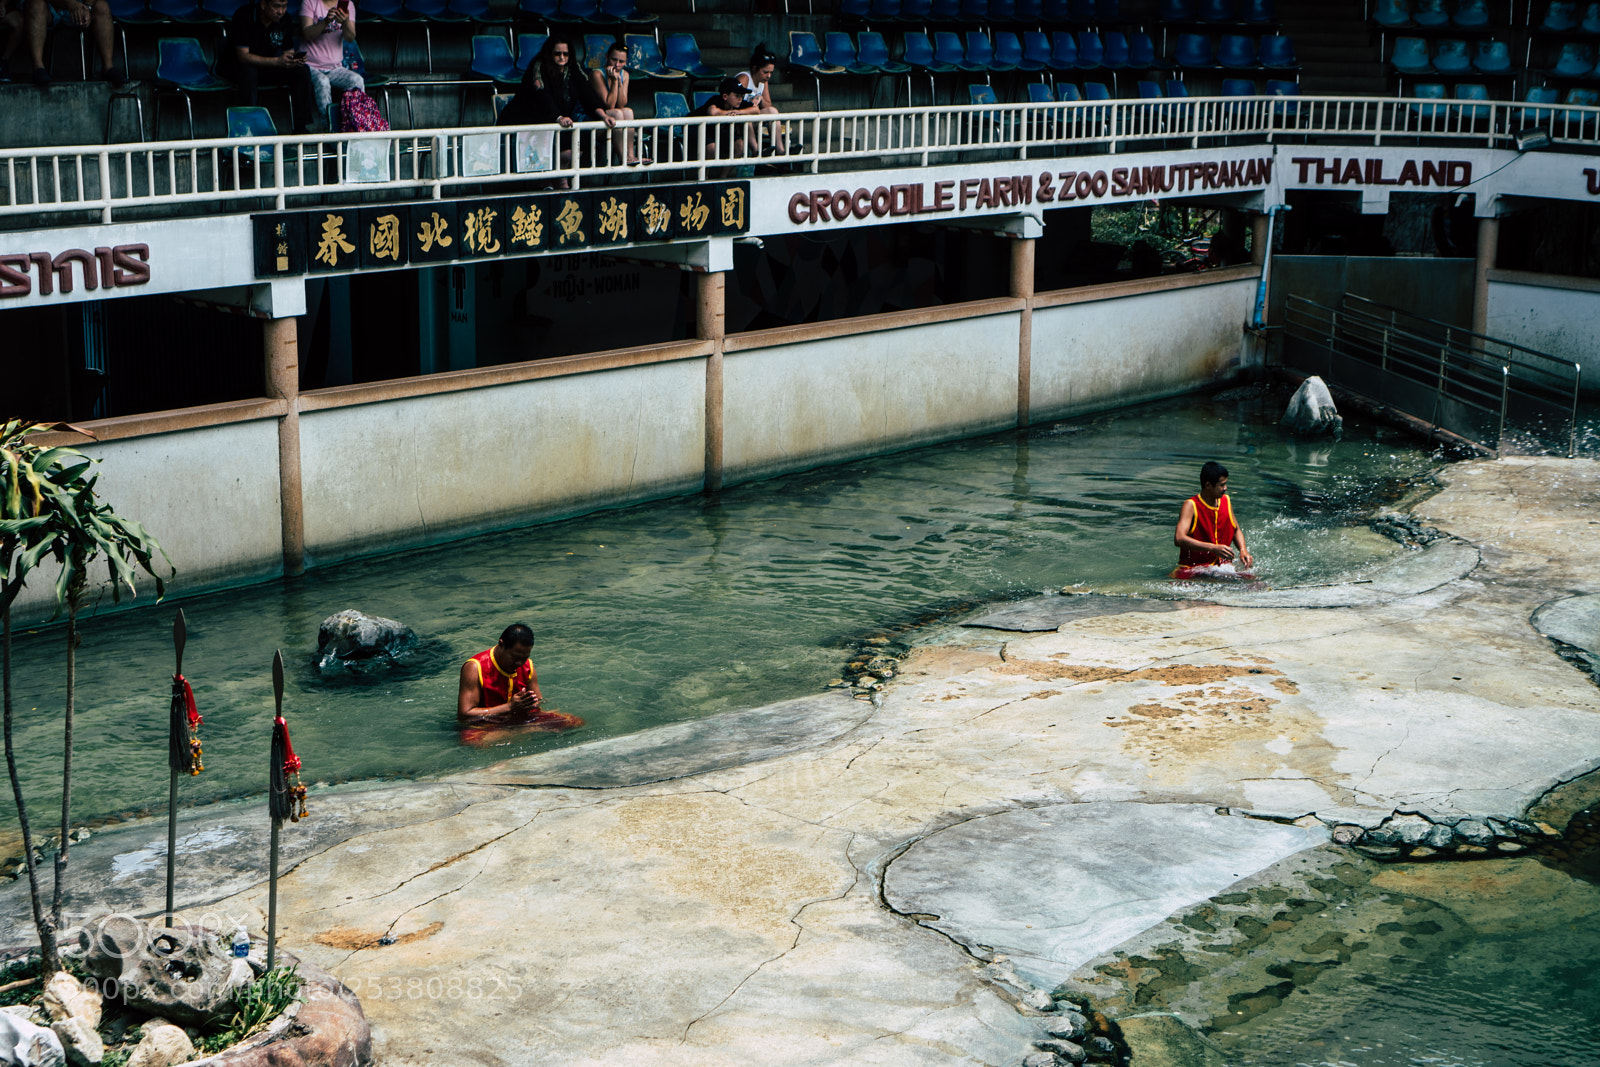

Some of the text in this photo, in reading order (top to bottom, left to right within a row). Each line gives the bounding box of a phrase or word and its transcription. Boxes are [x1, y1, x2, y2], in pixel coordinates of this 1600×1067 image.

[1291, 157, 1472, 187] THAILAND
[788, 156, 1272, 225] CROCODILE FARM & ZOO SAMUTPRAKAN
[451, 312, 468, 323] MAN
